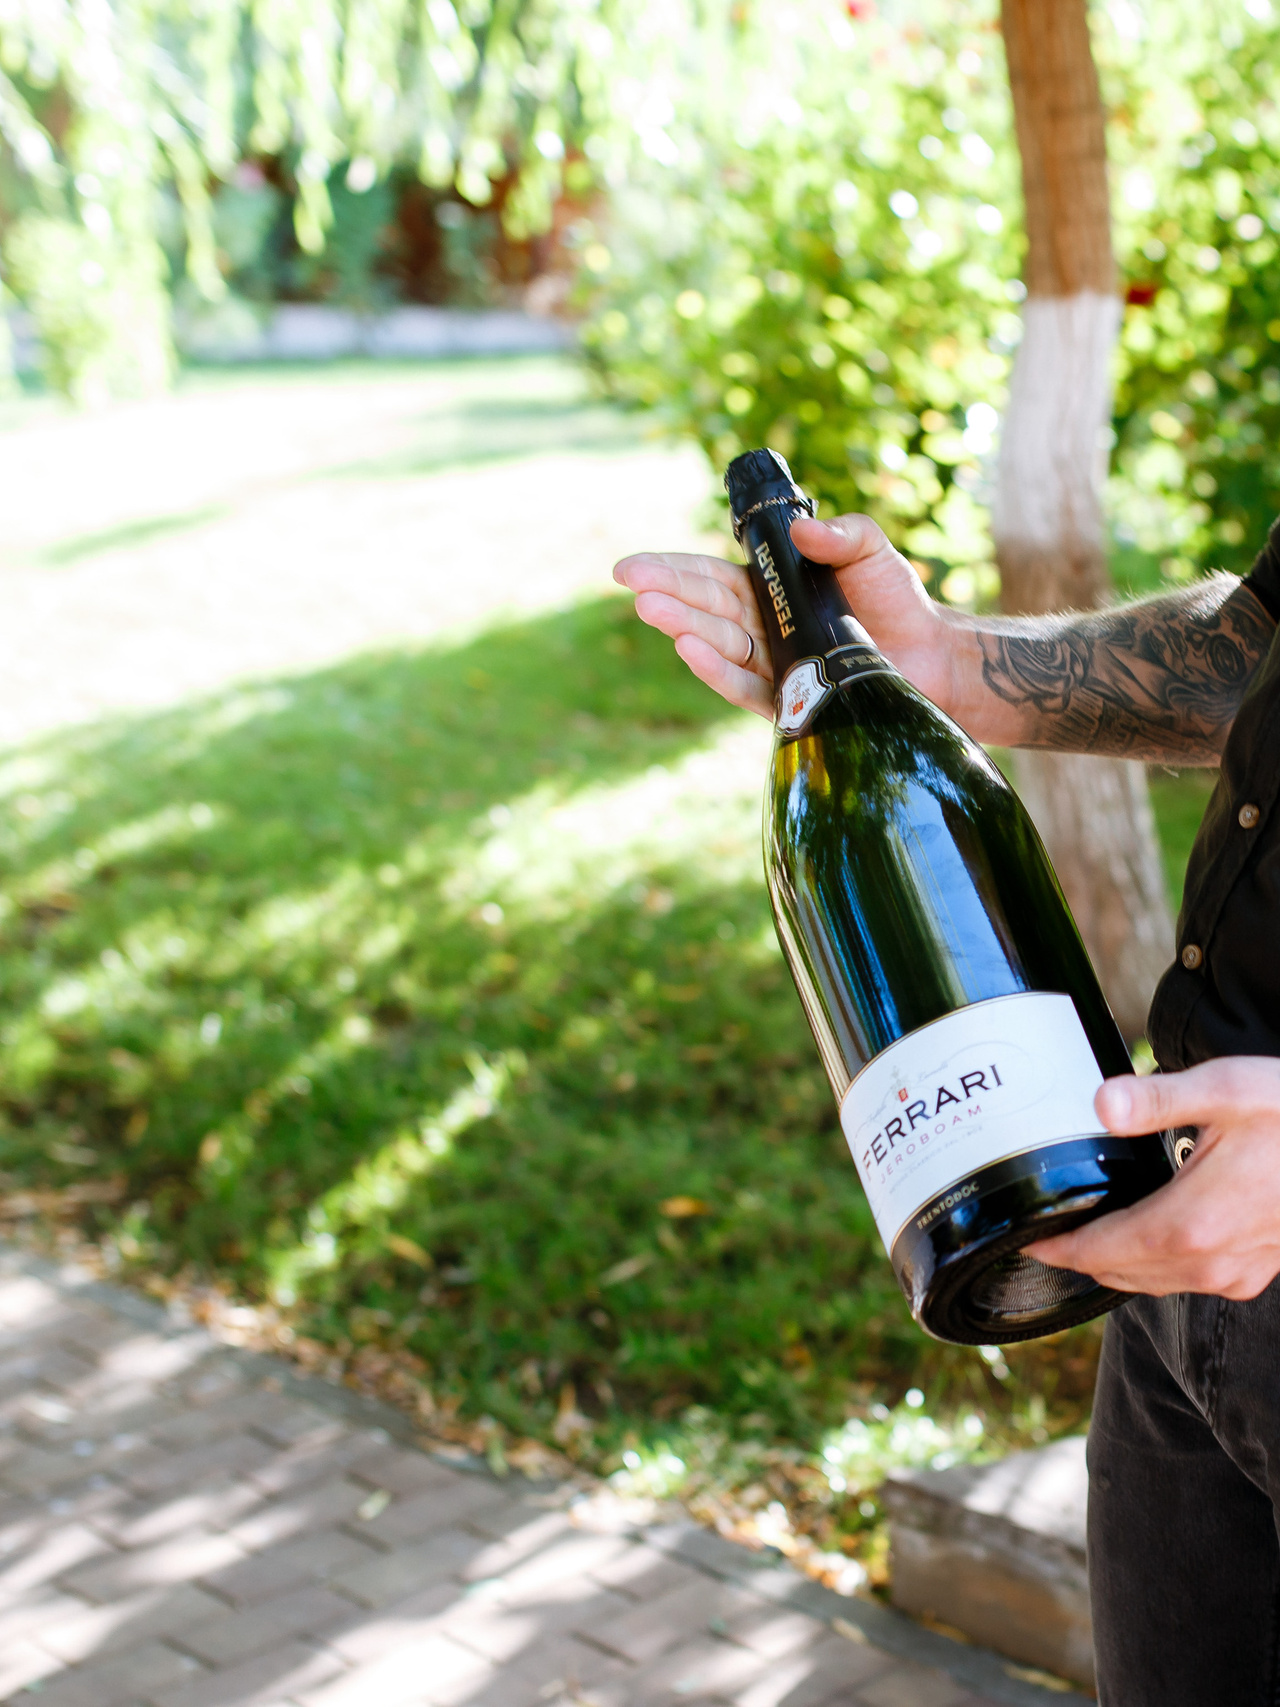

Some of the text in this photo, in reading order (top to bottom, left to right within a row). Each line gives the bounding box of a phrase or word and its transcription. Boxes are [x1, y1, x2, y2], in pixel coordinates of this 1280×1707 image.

[755, 541, 796, 640] FERRARI
[863, 1064, 1002, 1181] FERRARI
[880, 1104, 982, 1185] JEROBOAM
[916, 1181, 980, 1230] TRENTODOC
